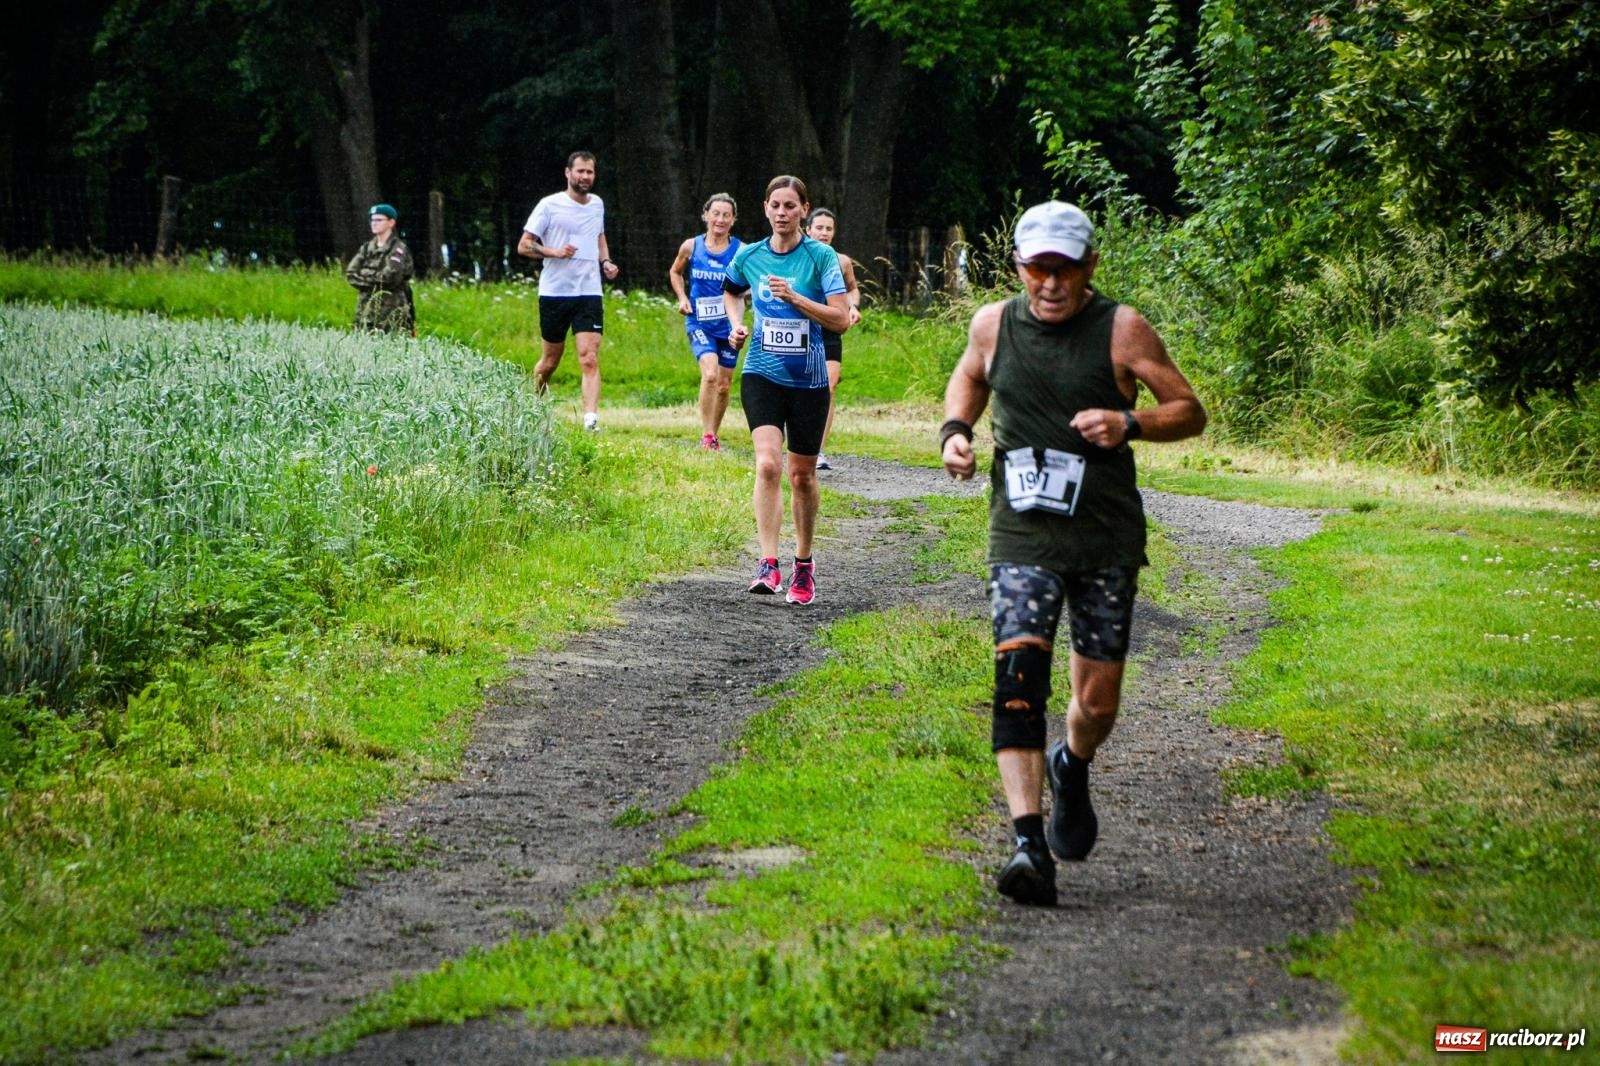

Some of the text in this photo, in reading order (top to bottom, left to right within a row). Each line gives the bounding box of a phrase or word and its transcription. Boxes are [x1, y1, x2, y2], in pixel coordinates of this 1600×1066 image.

[692, 268, 726, 282] RUNNI
[704, 305, 718, 315] 171
[770, 330, 794, 344] 180
[1018, 471, 1049, 492] 191
